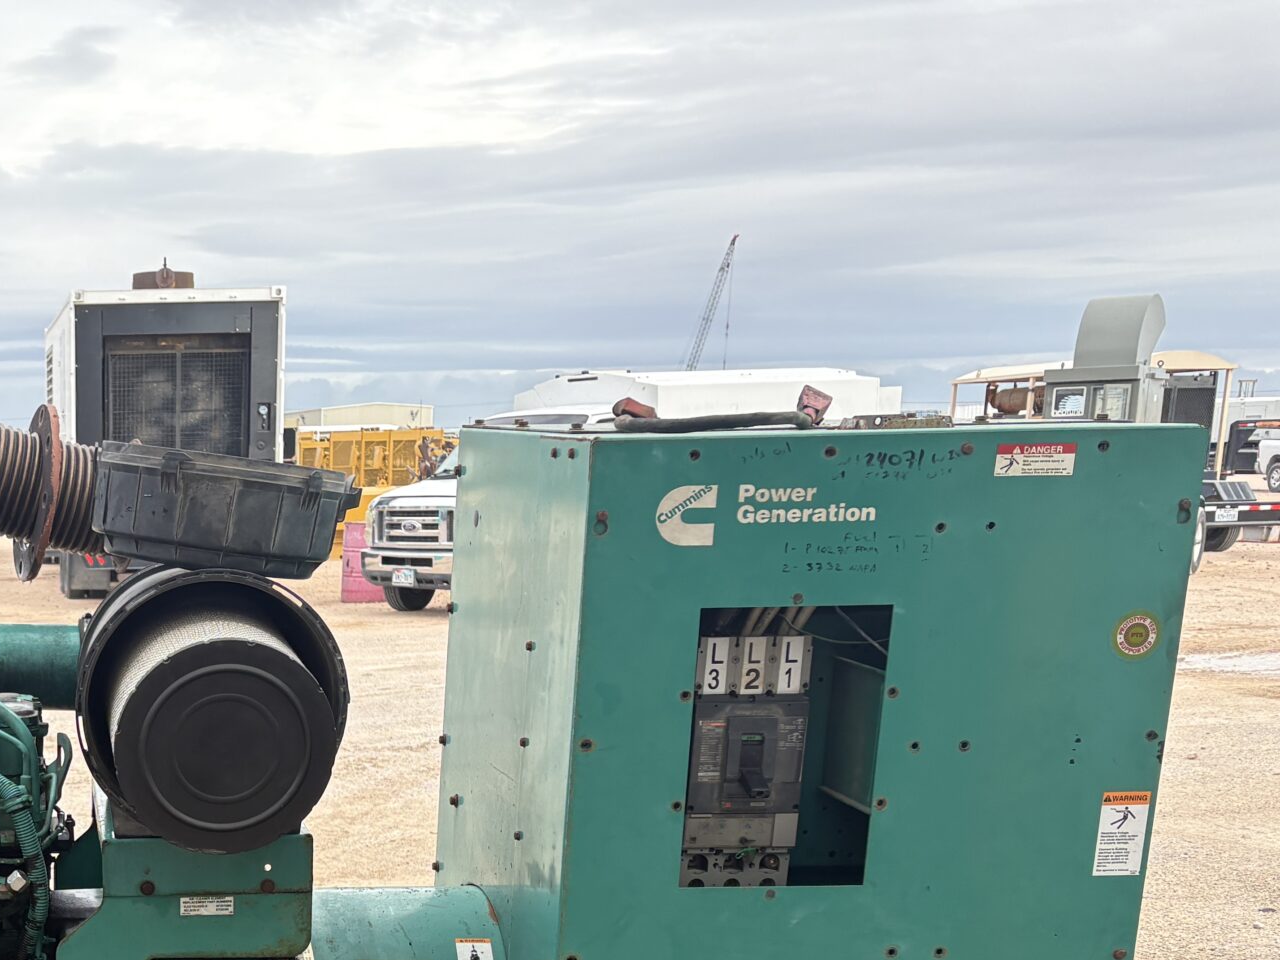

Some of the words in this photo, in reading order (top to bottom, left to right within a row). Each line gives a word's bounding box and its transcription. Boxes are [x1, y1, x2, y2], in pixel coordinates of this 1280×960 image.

[1023, 445, 1064, 454] DANGER
[738, 484, 817, 503] Power
[657, 484, 714, 525] Cummins
[736, 503, 876, 524] Generation
[1111, 794, 1148, 802] WARNING
